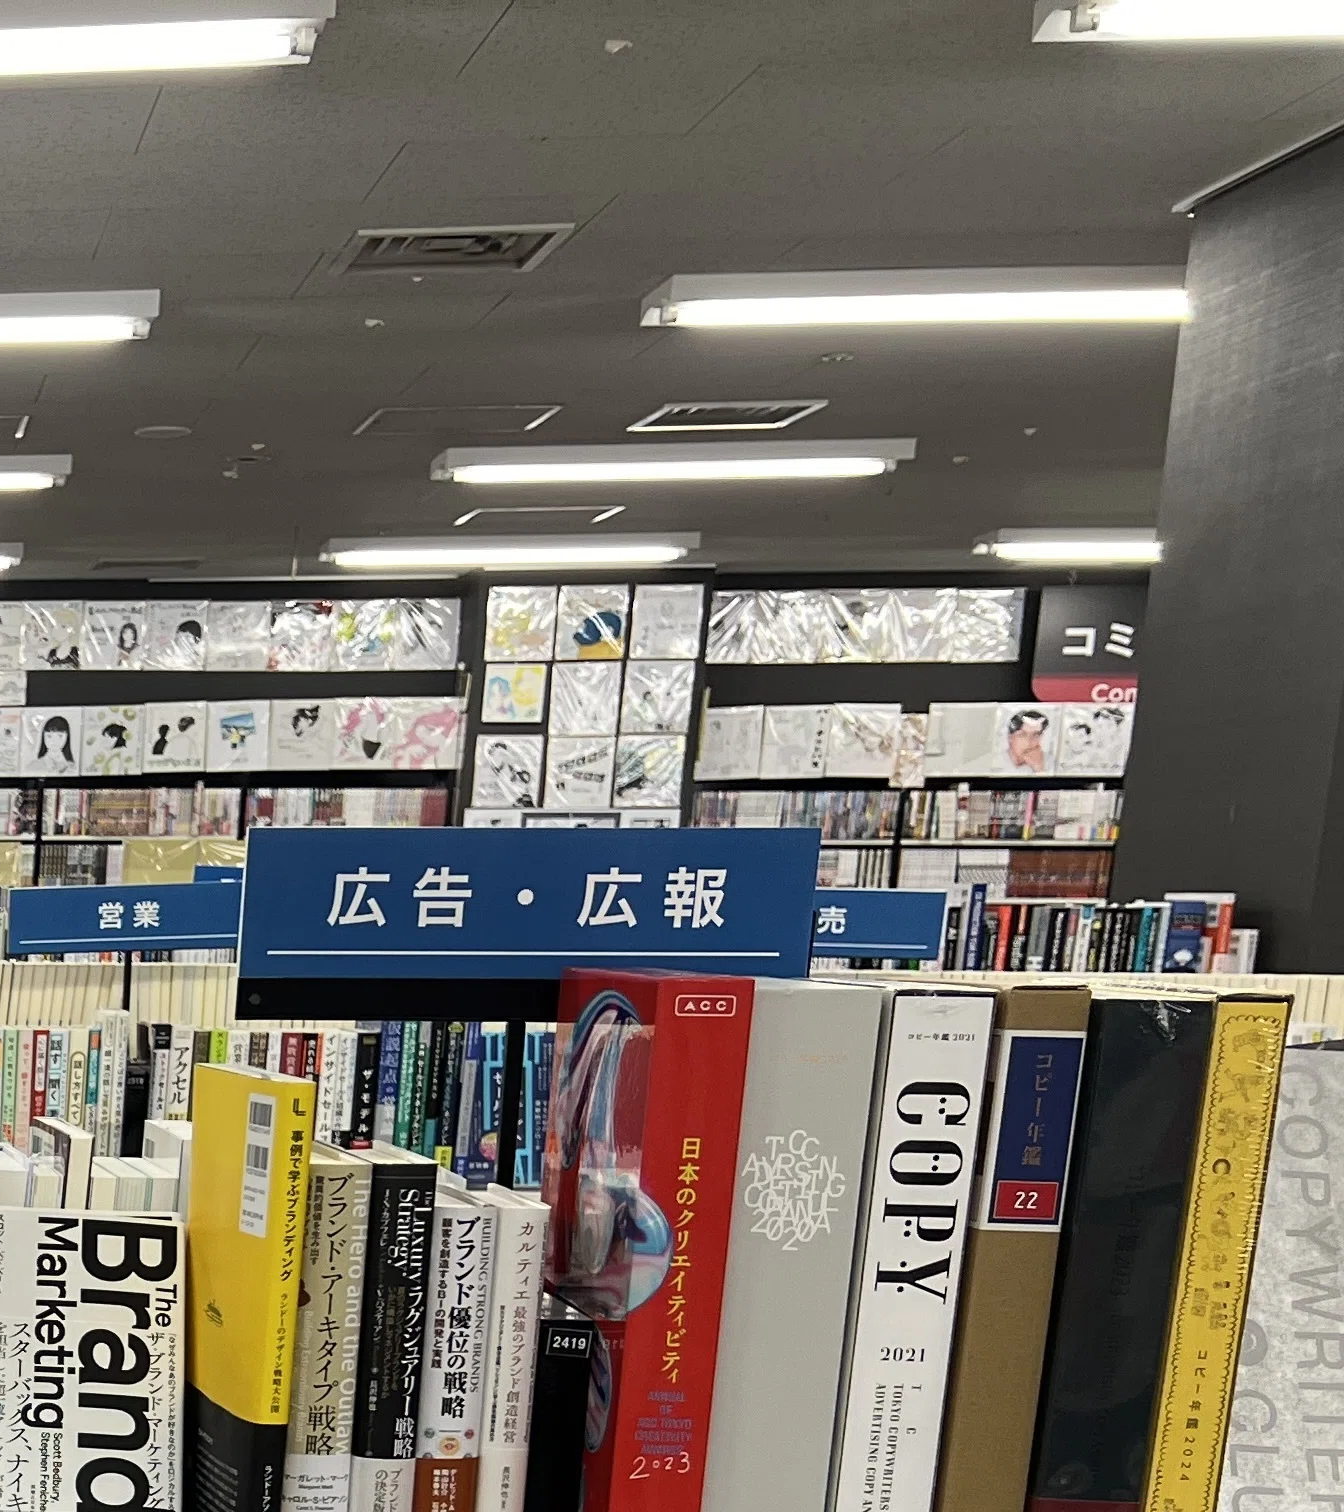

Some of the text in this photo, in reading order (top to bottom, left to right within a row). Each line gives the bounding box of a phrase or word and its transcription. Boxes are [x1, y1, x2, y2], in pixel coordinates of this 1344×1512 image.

[98, 902, 159, 928] 営業
[329, 867, 726, 928] 広告・広報
[684, 1000, 727, 1012] ACC
[873, 1080, 972, 1305] COPY
[1013, 1191, 1038, 1211] 22
[658, 1137, 702, 1386] 日本のクリエイティビティ
[20, 1216, 81, 1429] Marketing
[152, 1284, 179, 1328] The
[440, 1216, 483, 1419] ブランド優位の戦略
[552, 1335, 587, 1351] 2419
[881, 1347, 926, 1363] 2021
[629, 1452, 691, 1480] 2023
